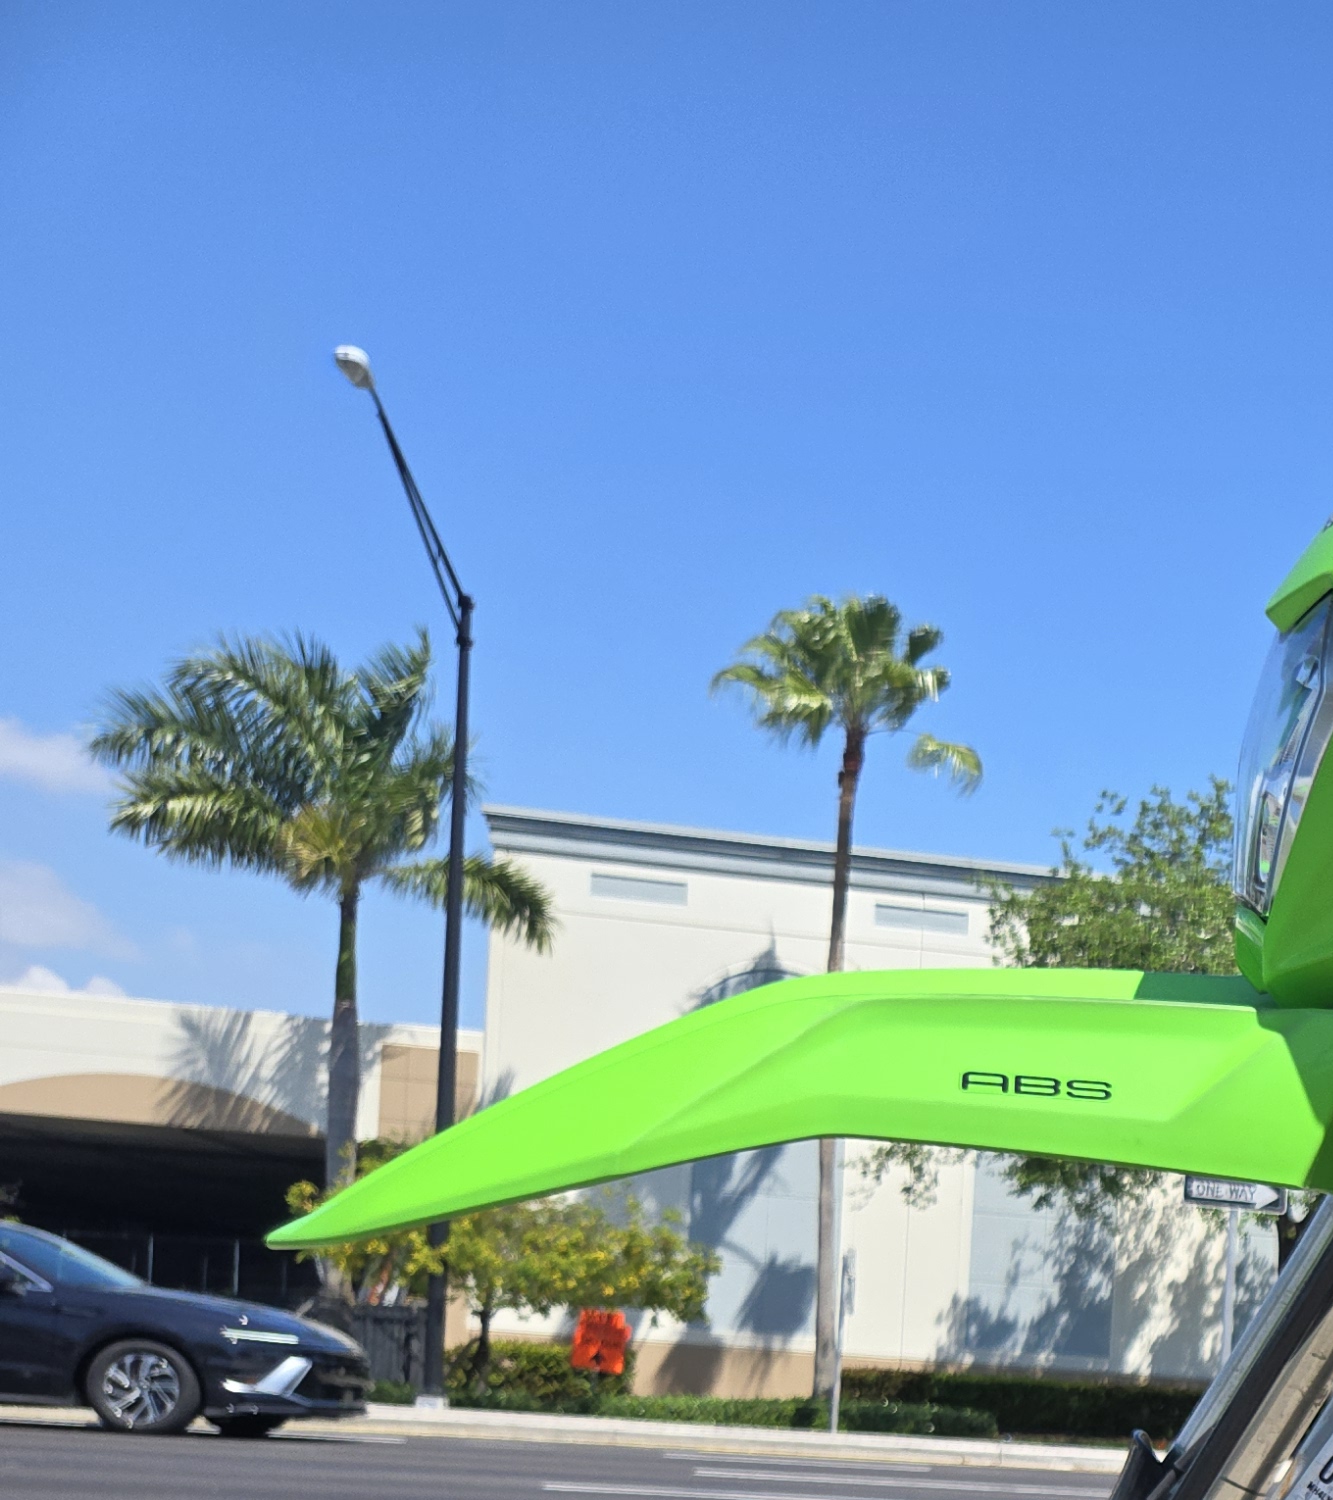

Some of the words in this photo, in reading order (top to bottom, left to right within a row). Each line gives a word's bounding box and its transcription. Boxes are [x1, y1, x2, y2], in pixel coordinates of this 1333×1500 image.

[962, 1071, 1112, 1100] ABS
[1197, 1181, 1223, 1198] ONE
[1229, 1184, 1257, 1201] WAY
